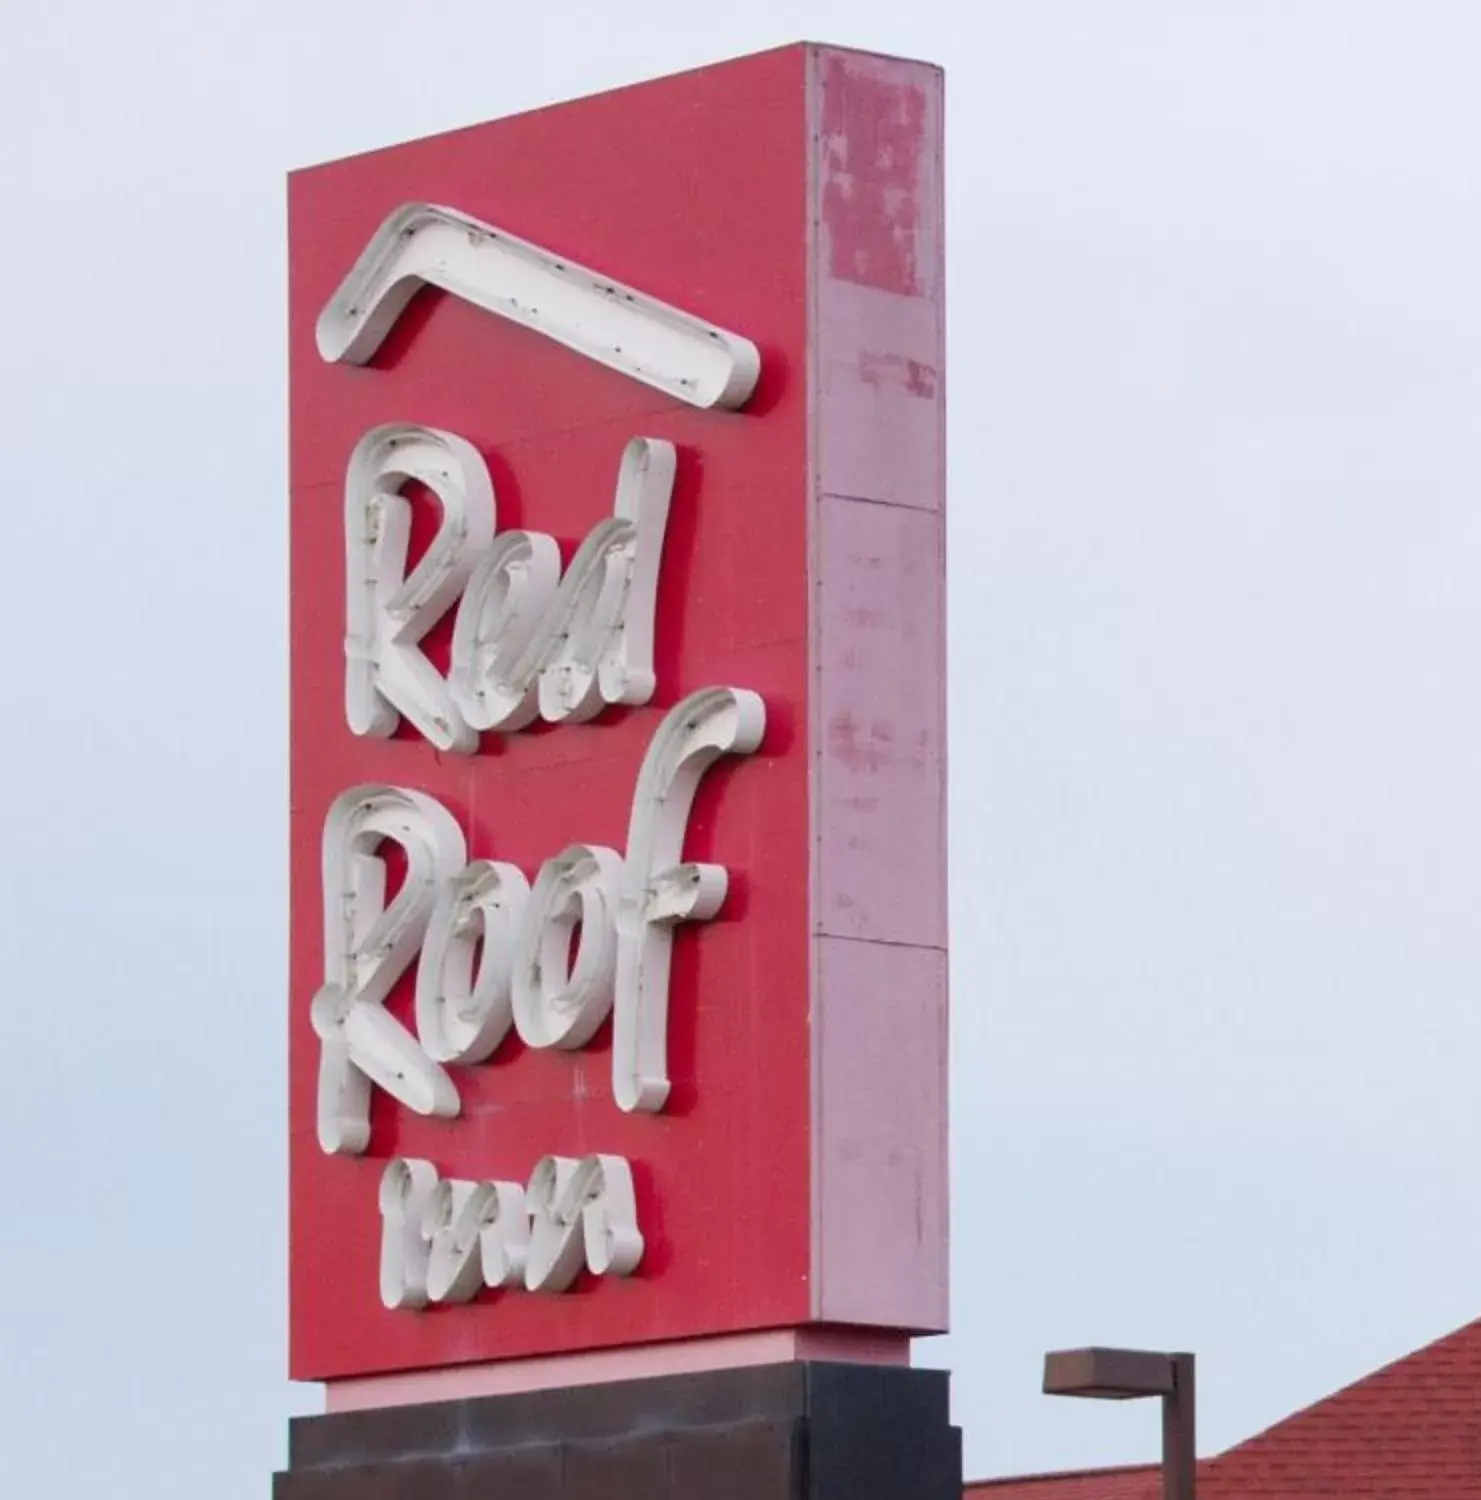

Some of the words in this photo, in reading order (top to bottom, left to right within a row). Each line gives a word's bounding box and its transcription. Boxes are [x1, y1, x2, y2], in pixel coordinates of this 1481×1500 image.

[344, 426, 676, 752] Red
[311, 687, 765, 1154] Roof
[380, 1154, 643, 1309] Inn
